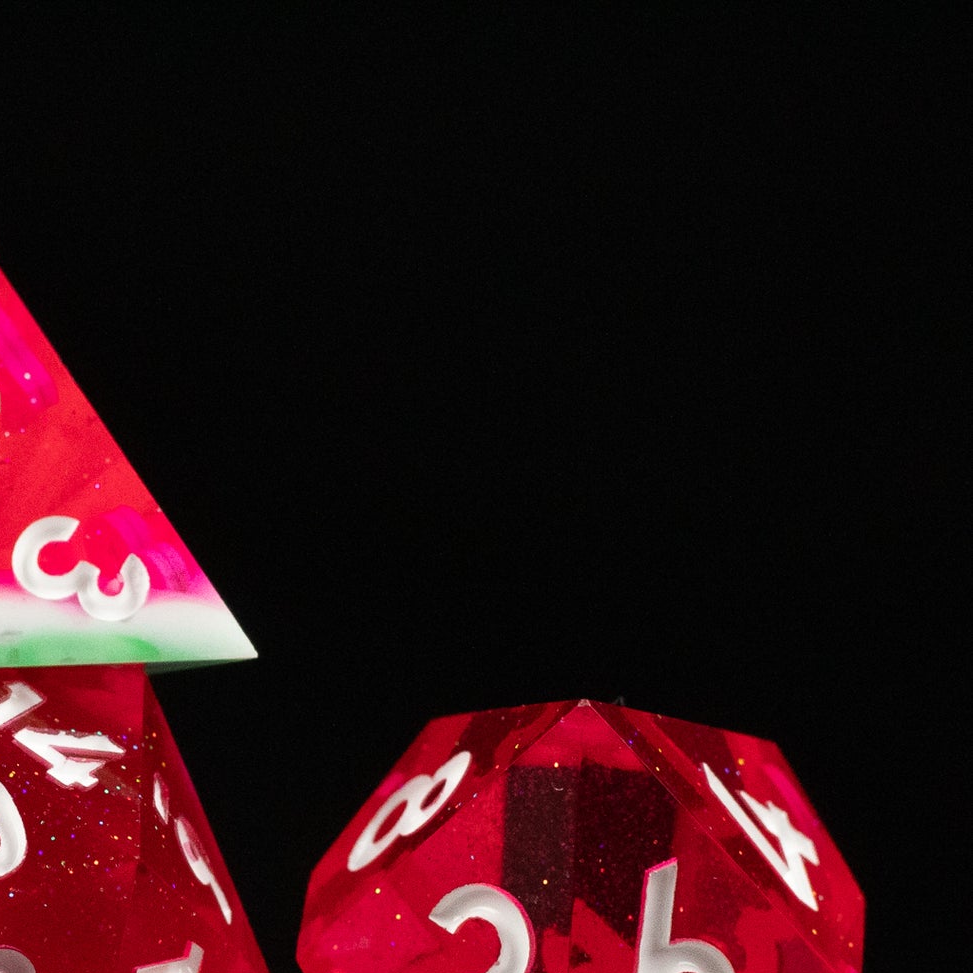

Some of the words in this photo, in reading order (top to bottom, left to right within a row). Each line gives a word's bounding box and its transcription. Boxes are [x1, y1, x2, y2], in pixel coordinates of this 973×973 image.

[11, 515, 151, 621] 3
[347, 751, 472, 872] 8
[701, 762, 821, 912] 4
